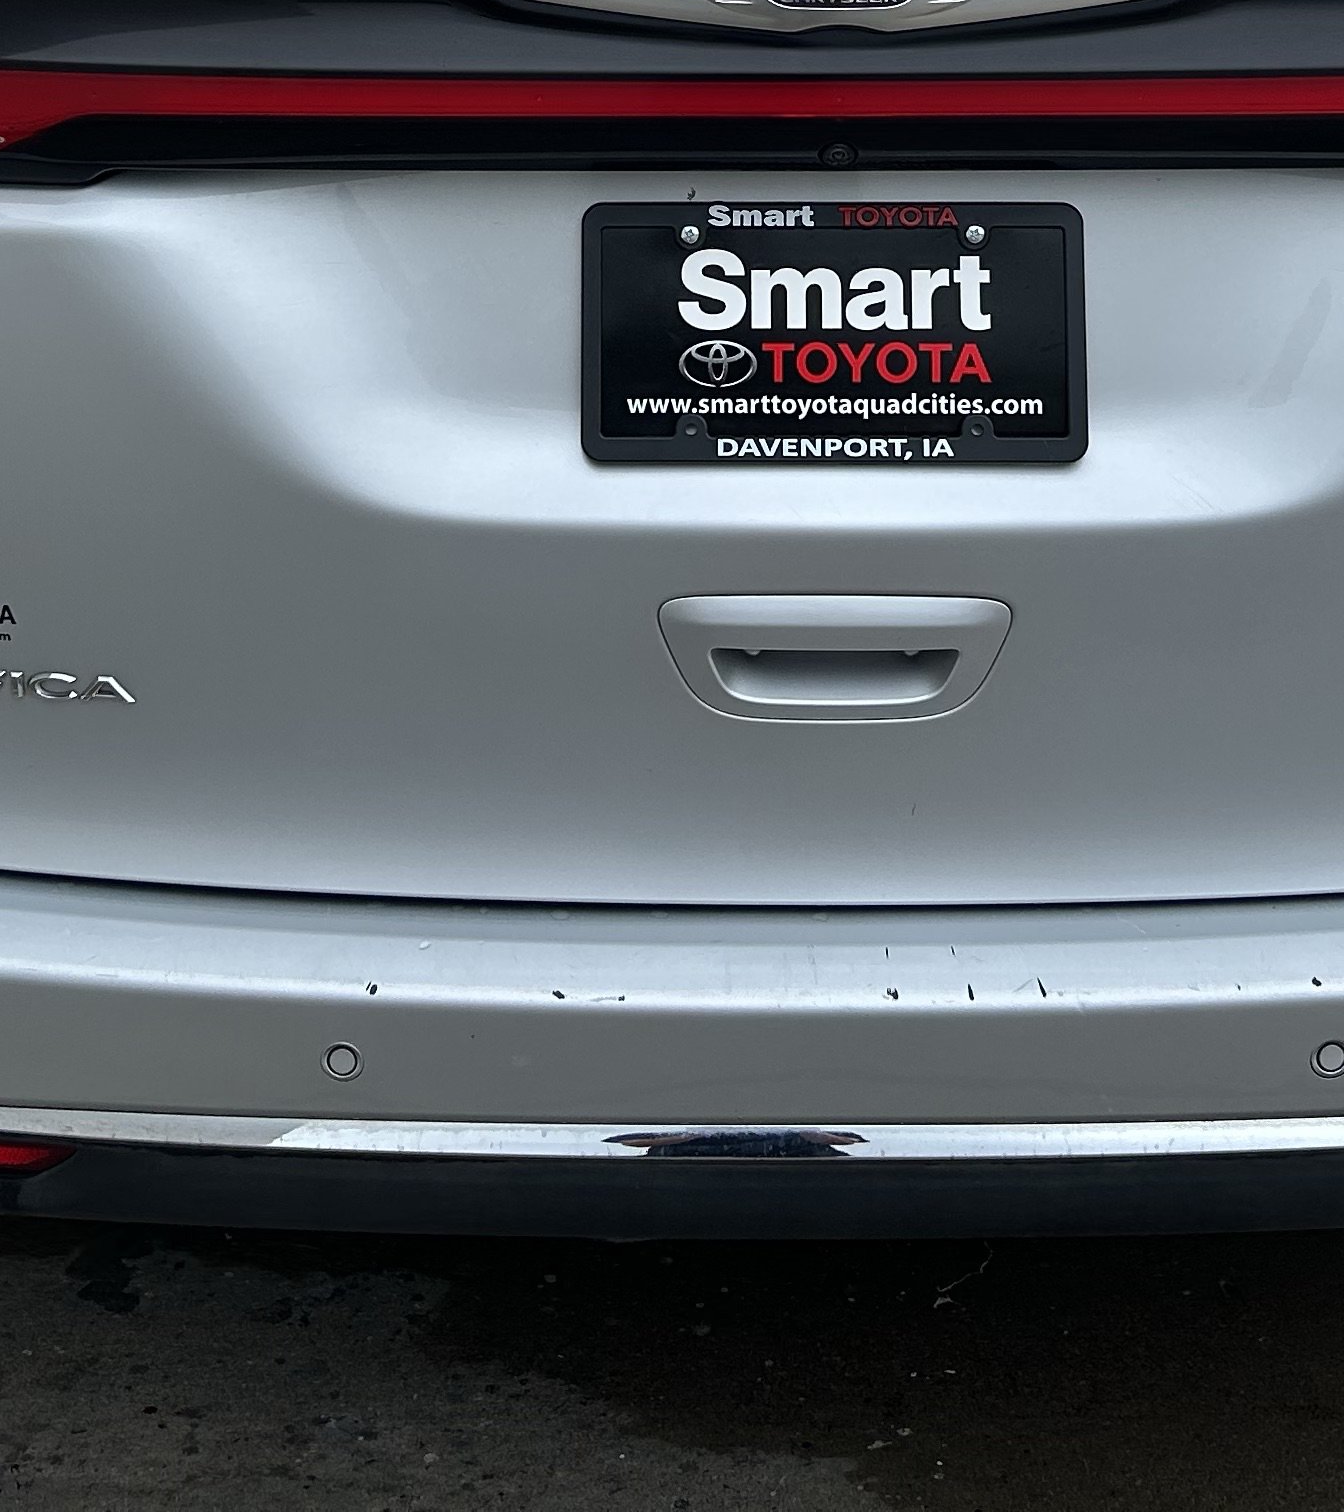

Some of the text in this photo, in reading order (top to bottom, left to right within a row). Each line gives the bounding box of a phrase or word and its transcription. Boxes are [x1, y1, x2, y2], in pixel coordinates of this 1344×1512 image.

[707, 204, 958, 227] Smart TOYOTA
[677, 248, 992, 332] Smart
[761, 342, 992, 384] TOYOTA
[626, 393, 1043, 420] www.smarttoyotaquadcities.com
[716, 438, 955, 461] DAVENPORT, IA
